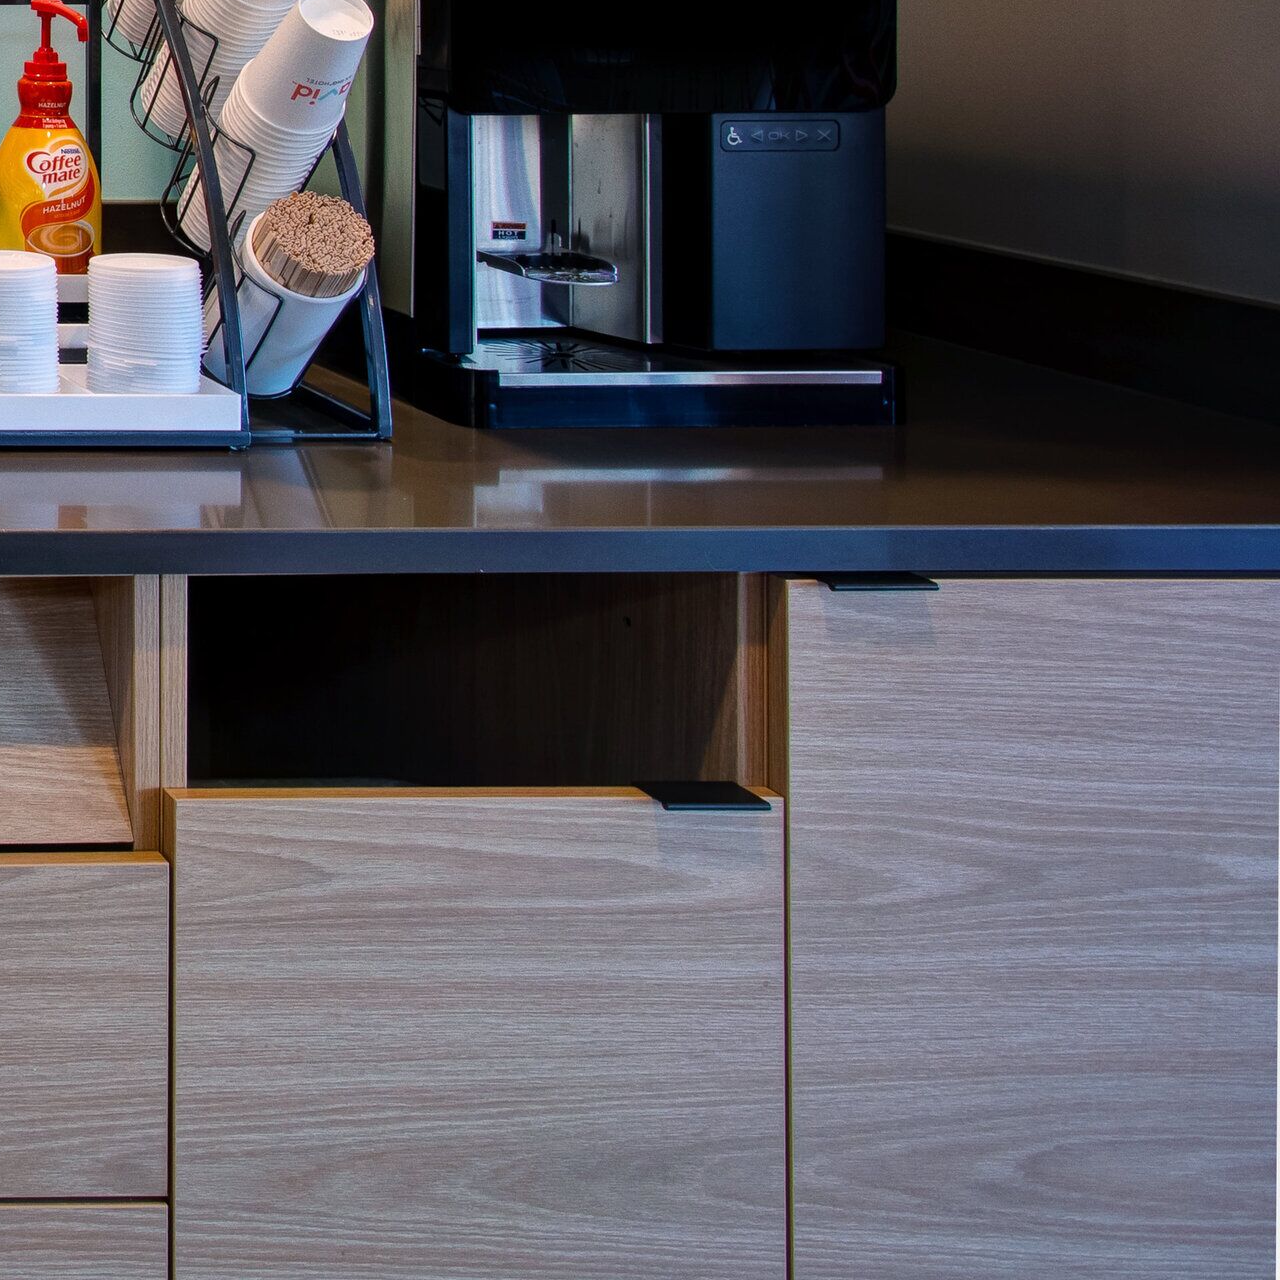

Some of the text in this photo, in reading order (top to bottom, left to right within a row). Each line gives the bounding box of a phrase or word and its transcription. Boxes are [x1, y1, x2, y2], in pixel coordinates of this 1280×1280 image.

[26, 151, 81, 174] Coffee
[42, 168, 80, 184] mate
[42, 196, 86, 214] HAZELNUT
